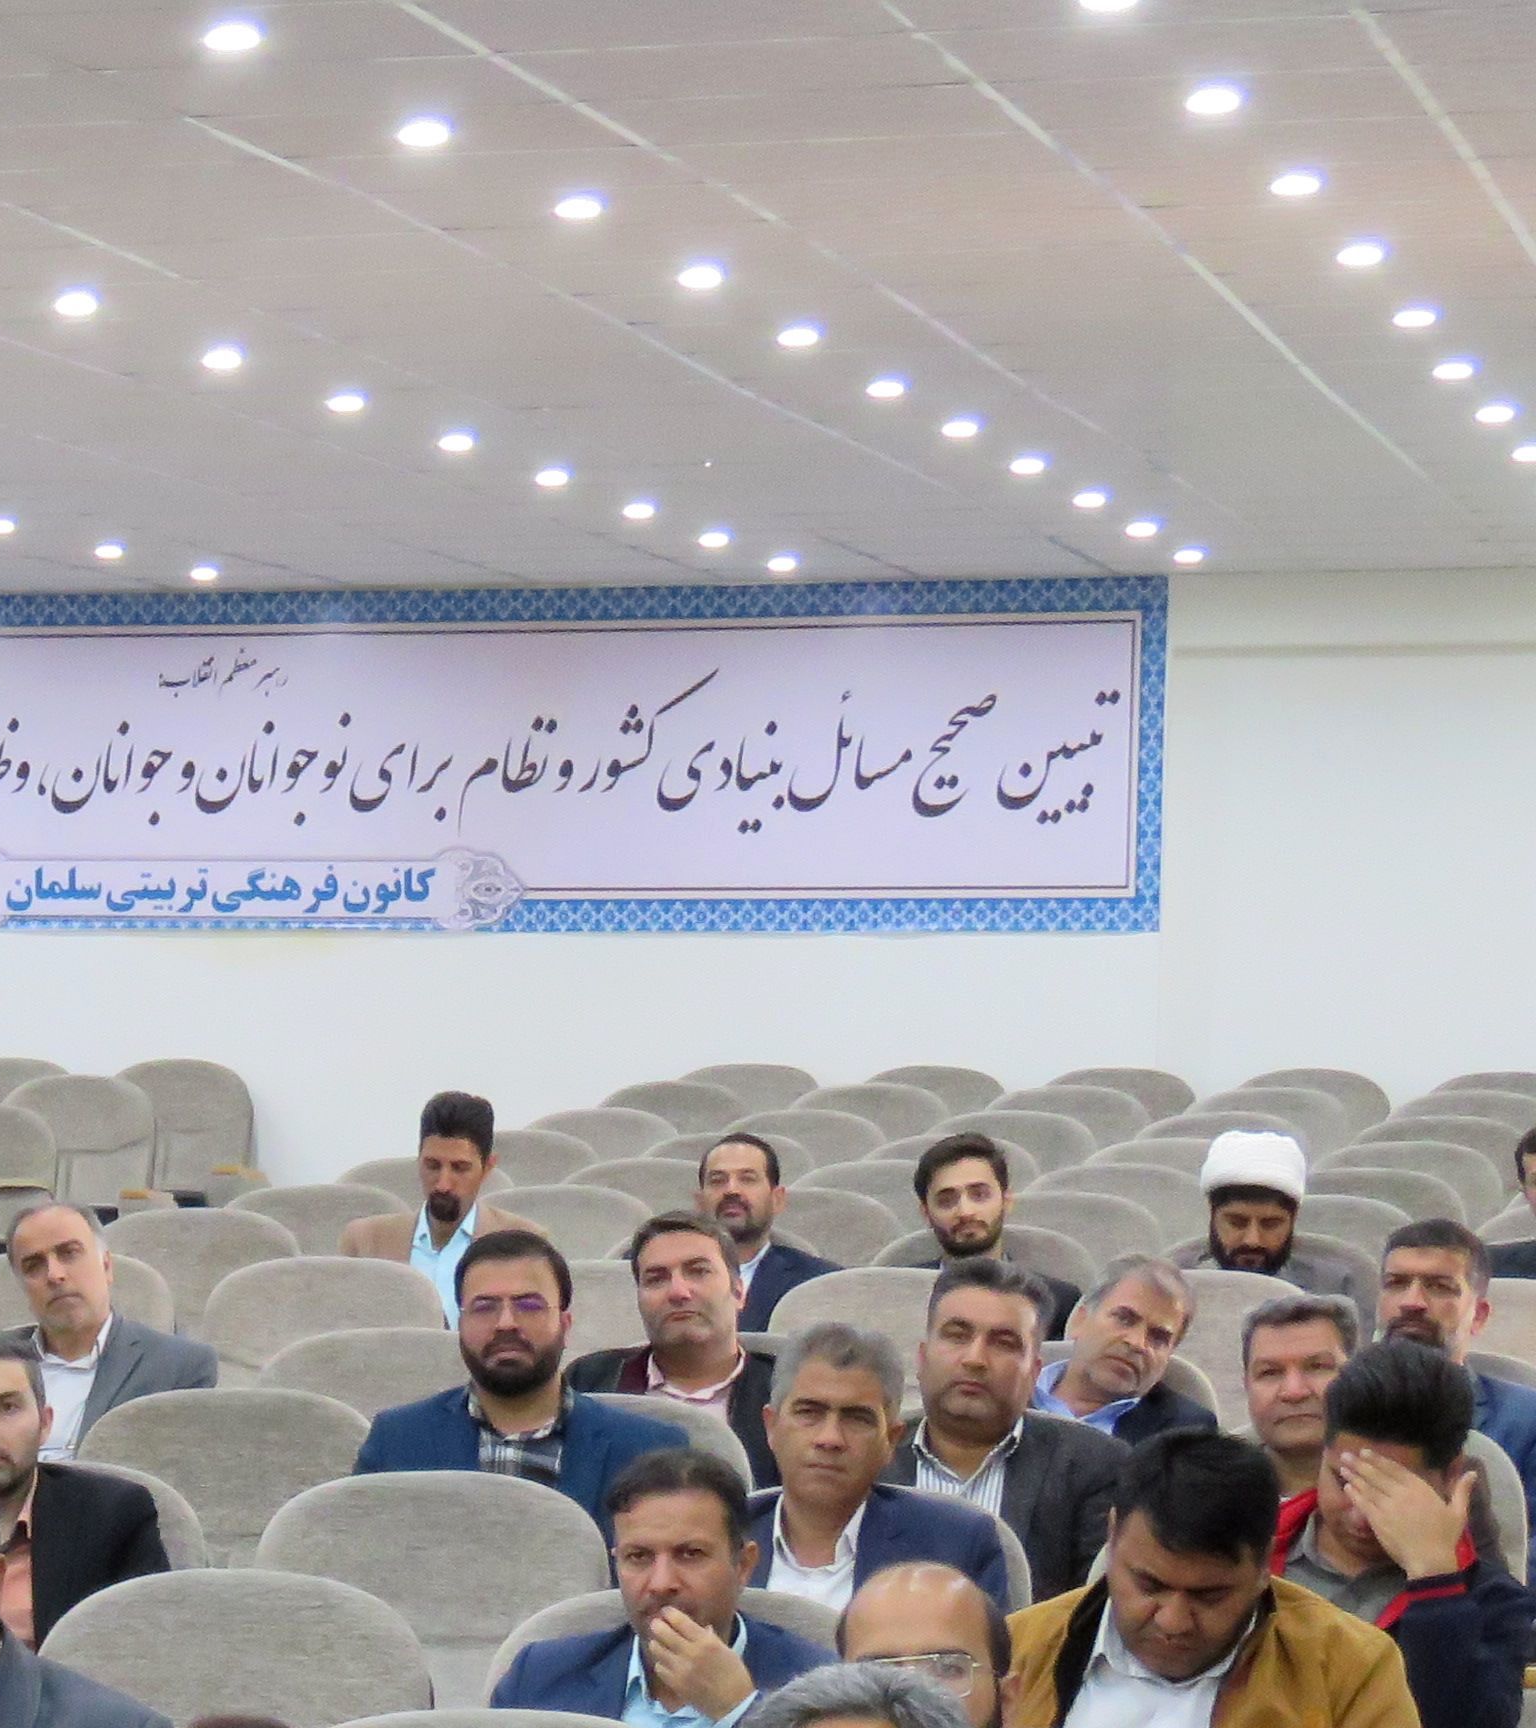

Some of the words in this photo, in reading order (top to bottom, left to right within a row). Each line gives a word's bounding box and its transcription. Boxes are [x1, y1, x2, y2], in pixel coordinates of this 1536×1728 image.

[219, 647, 258, 696] معظم
[253, 666, 289, 698] رهبر
[578, 668, 719, 794] کشور
[787, 693, 913, 813] مسائل
[911, 693, 997, 818] صحیح
[995, 689, 1122, 825] تبیین
[176, 760, 197, 793] و
[194, 712, 352, 827] نوجوانان
[349, 743, 453, 822] برای
[456, 715, 559, 836] نظام
[554, 759, 575, 793] و
[656, 720, 785, 835] بنیادی
[4, 866, 103, 913] سلمان
[105, 865, 209, 913] تربیتی
[211, 864, 339, 914] فرهنگی
[342, 866, 437, 914] کانون
